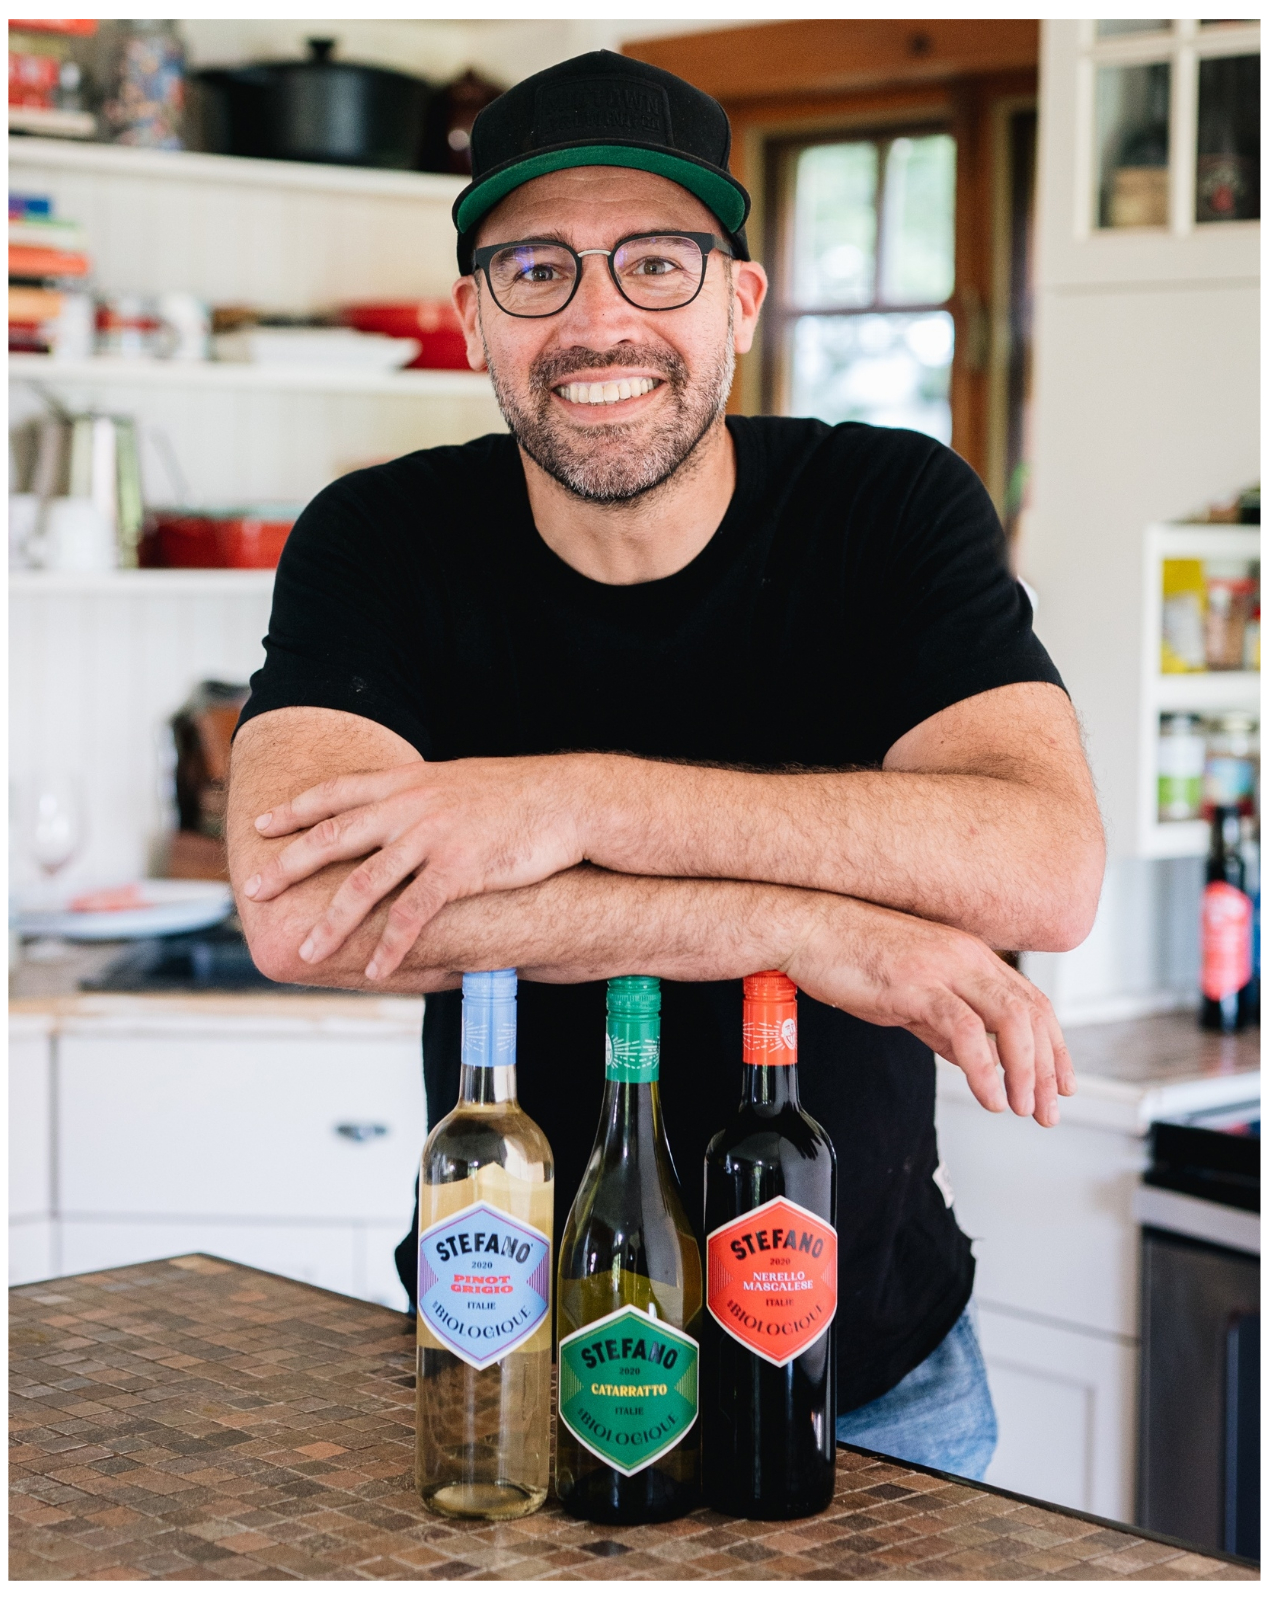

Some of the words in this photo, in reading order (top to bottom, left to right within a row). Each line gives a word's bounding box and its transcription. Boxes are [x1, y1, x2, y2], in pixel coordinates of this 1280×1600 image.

[435, 1231, 532, 1264] STEFANO
[730, 1228, 824, 1261] STEFANO
[471, 1260, 493, 1270] 2020
[769, 1257, 791, 1266] 2020
[453, 1273, 511, 1285] PINOT
[752, 1270, 805, 1281] NERELLO
[450, 1283, 514, 1295] GRIGIO
[742, 1280, 814, 1292] MASCALESE
[467, 1300, 496, 1311] ITALIE
[434, 1303, 532, 1339] BIOLOGIQUE
[580, 1337, 679, 1370] STEFANO
[619, 1366, 641, 1376] 2020
[591, 1382, 668, 1397] CATARRATTO
[615, 1406, 644, 1416] ITALIE
